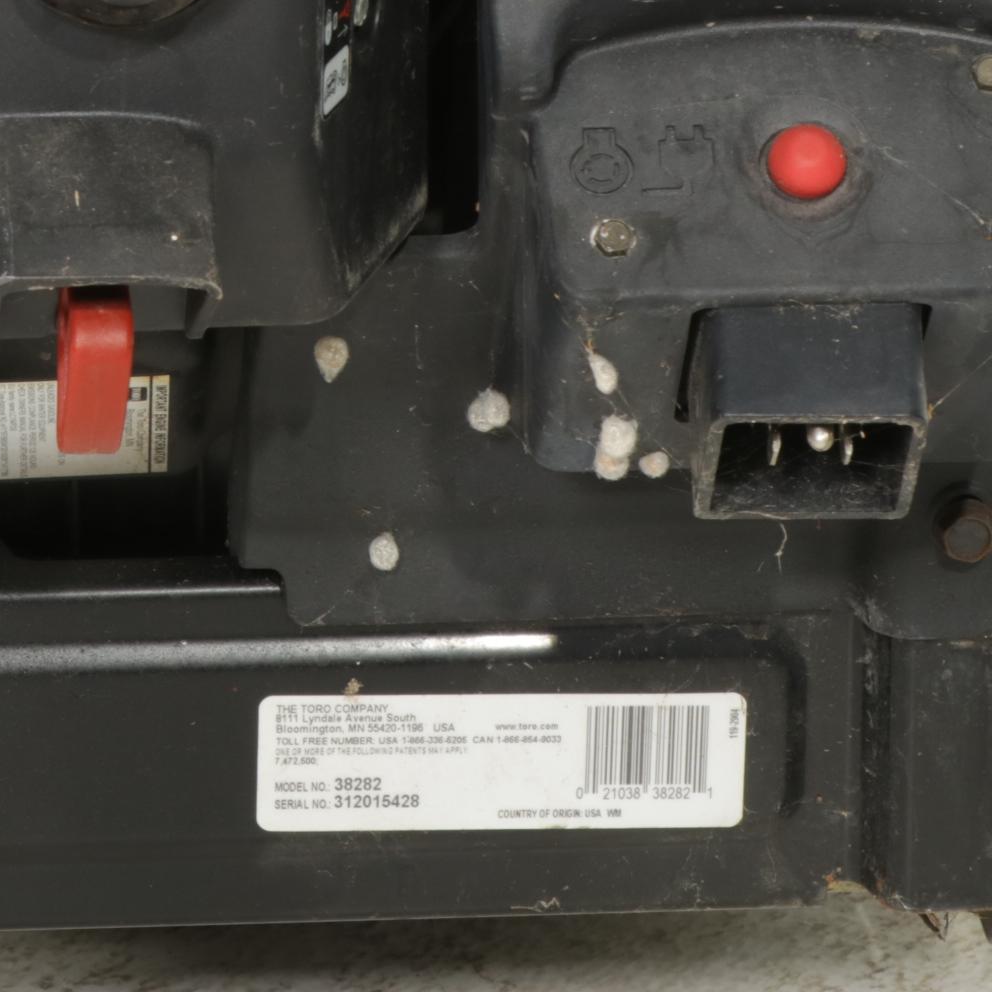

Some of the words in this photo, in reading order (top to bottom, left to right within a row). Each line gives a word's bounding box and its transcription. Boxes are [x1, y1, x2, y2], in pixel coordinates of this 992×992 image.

[277, 704, 297, 714] THE
[301, 704, 331, 714] TORO
[334, 703, 388, 714] COMPANY
[275, 714, 298, 723] 8111
[302, 713, 342, 725] Lyndale
[345, 713, 382, 723] Avenue
[386, 712, 416, 723] South
[275, 724, 345, 735] Bloomington,
[348, 723, 365, 733] MN
[433, 722, 455, 732] USA
[495, 722, 559, 731] www.toro.com
[276, 737, 299, 746] TOLL
[302, 737, 328, 746] FREE
[330, 736, 375, 746] NUMBER:
[378, 736, 397, 745] USA
[472, 735, 494, 744] CAN
[395, 746, 427, 755] PATENTS
[274, 781, 308, 792] MODEL
[334, 776, 382, 791] 38282
[575, 787, 584, 800] 0
[602, 787, 641, 800] 21038
[652, 786, 691, 799] 38282
[706, 787, 713, 799] 1
[274, 799, 309, 810] SERIAL
[334, 794, 420, 808] 312015428
[498, 809, 537, 819] COUNTRY
[539, 809, 550, 818] OF
[584, 808, 602, 818] USA
[606, 808, 622, 818] WM
